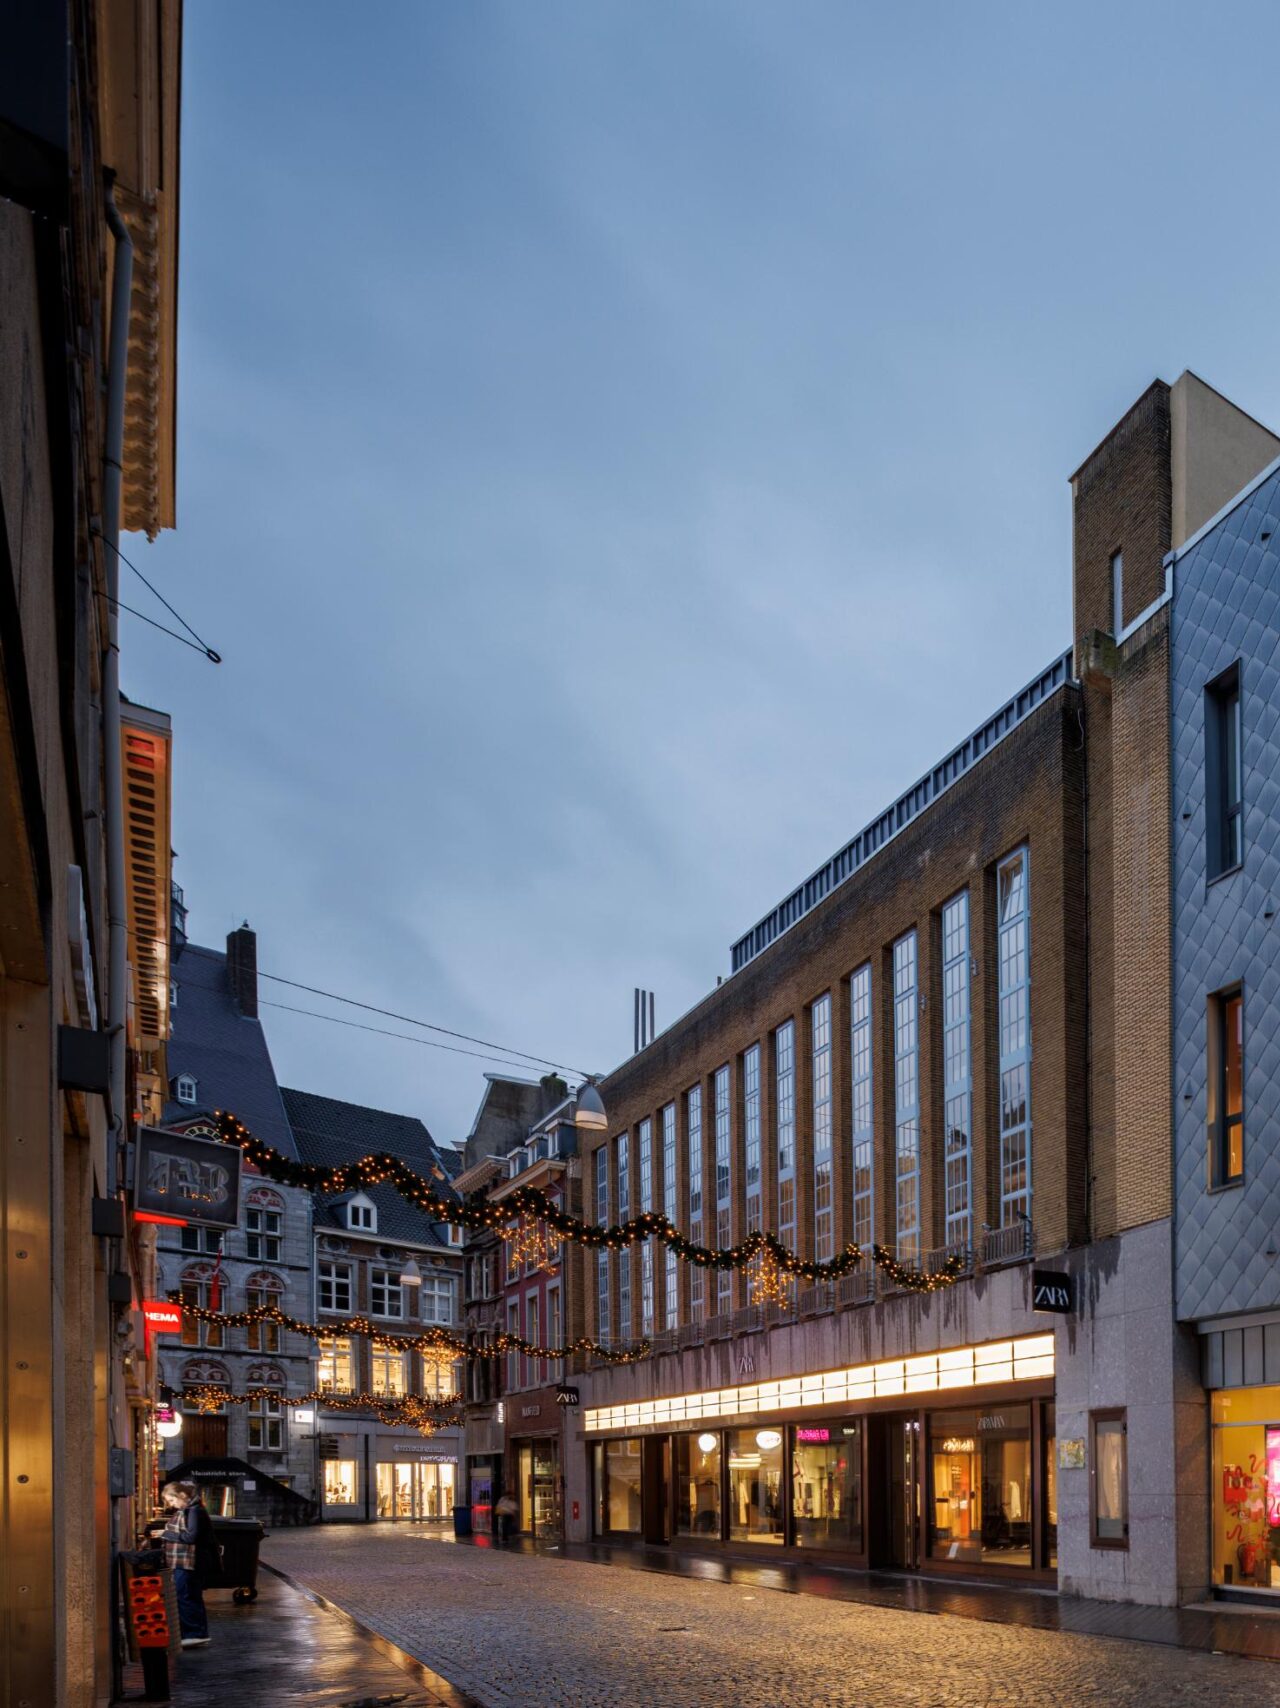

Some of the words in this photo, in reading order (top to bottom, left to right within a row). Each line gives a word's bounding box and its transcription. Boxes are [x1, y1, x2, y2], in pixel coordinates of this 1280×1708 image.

[1034, 1285, 1069, 1306] ZARA
[145, 1312, 179, 1322] HEMA
[556, 1392, 578, 1404] ZARA
